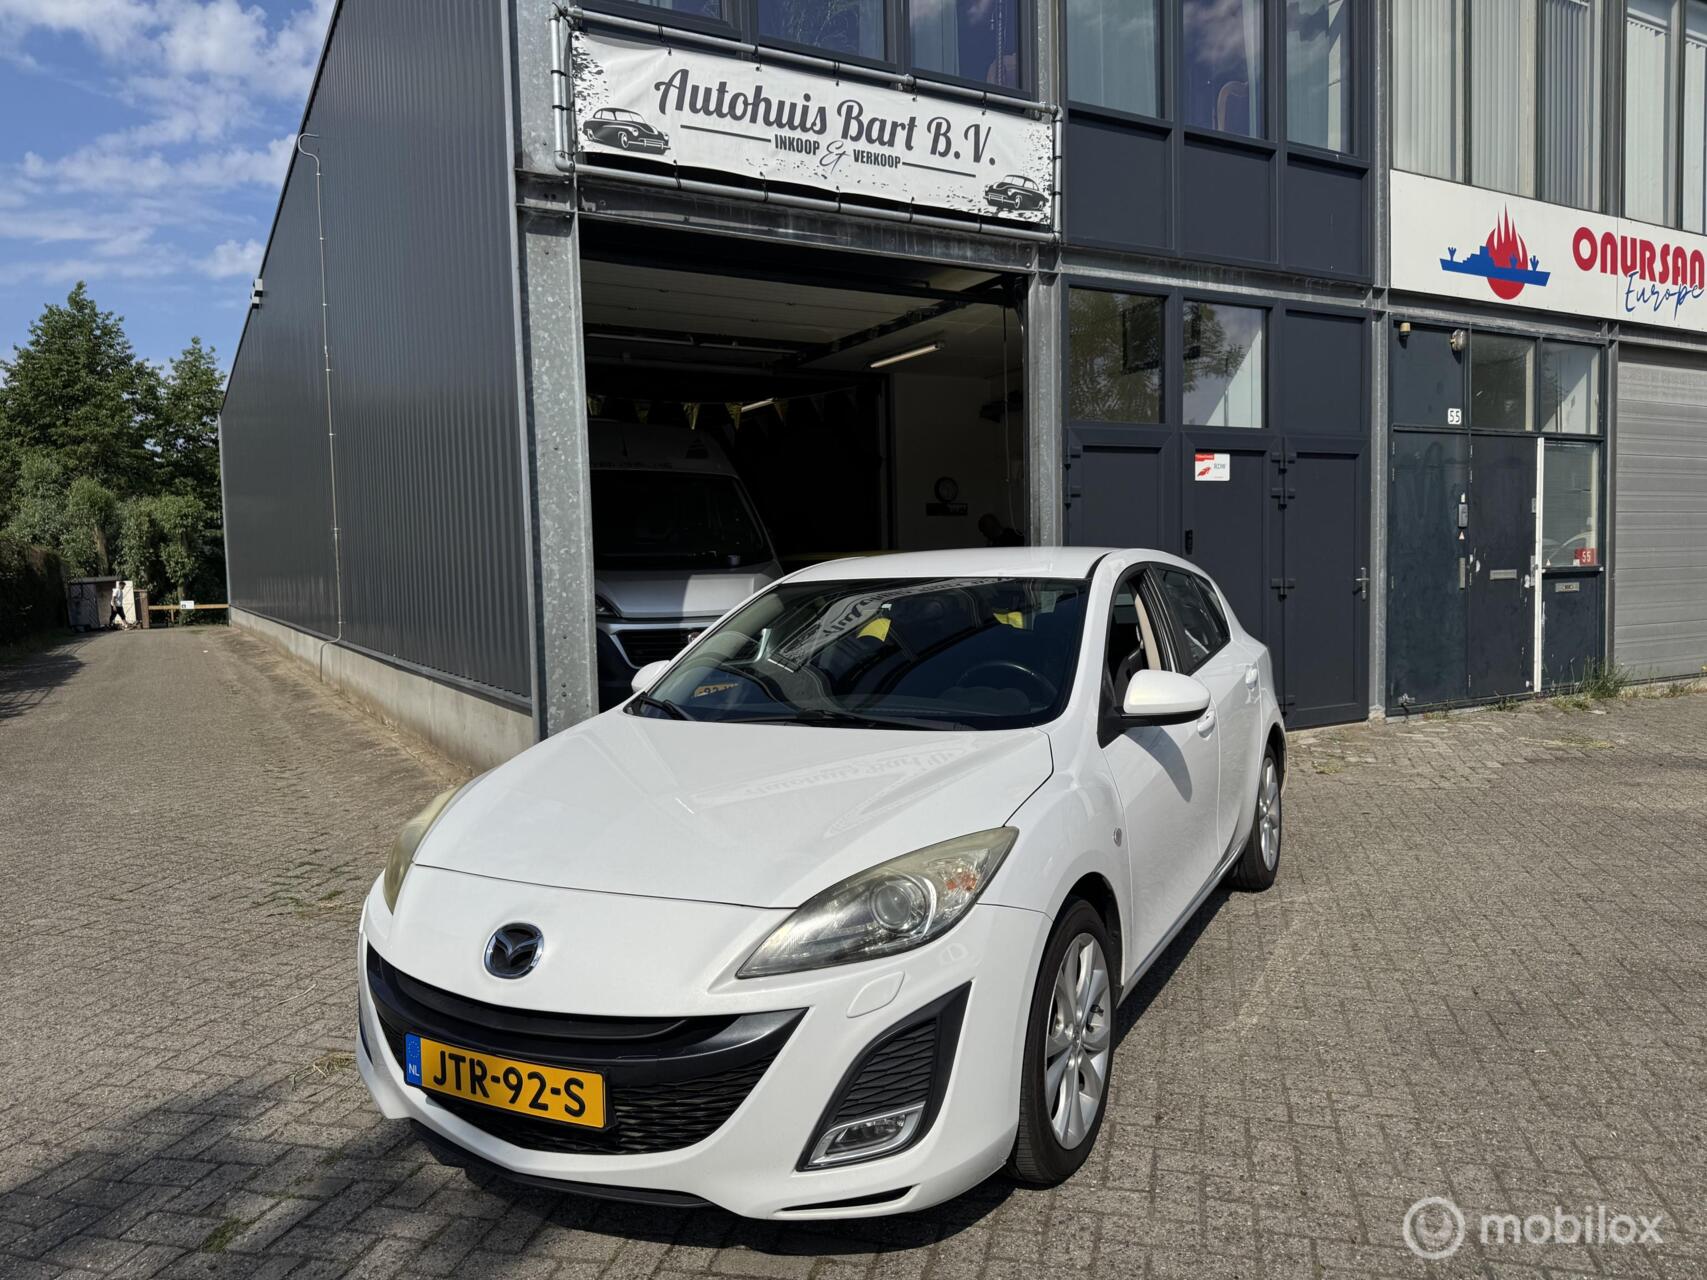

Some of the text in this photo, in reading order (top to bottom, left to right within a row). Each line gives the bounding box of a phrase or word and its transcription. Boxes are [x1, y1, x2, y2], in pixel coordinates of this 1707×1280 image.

[654, 68, 997, 166] Autohuis Bart B.V.
[774, 134, 821, 156] INKOOP
[853, 149, 902, 170] VERKOOP
[1572, 227, 1705, 289] ONURSAN
[1625, 271, 1705, 321] Europe
[1449, 410, 1461, 423] 55
[1581, 550, 1592, 563] 55
[408, 1063, 420, 1077] NL
[433, 1050, 586, 1118] JTR-92-S
